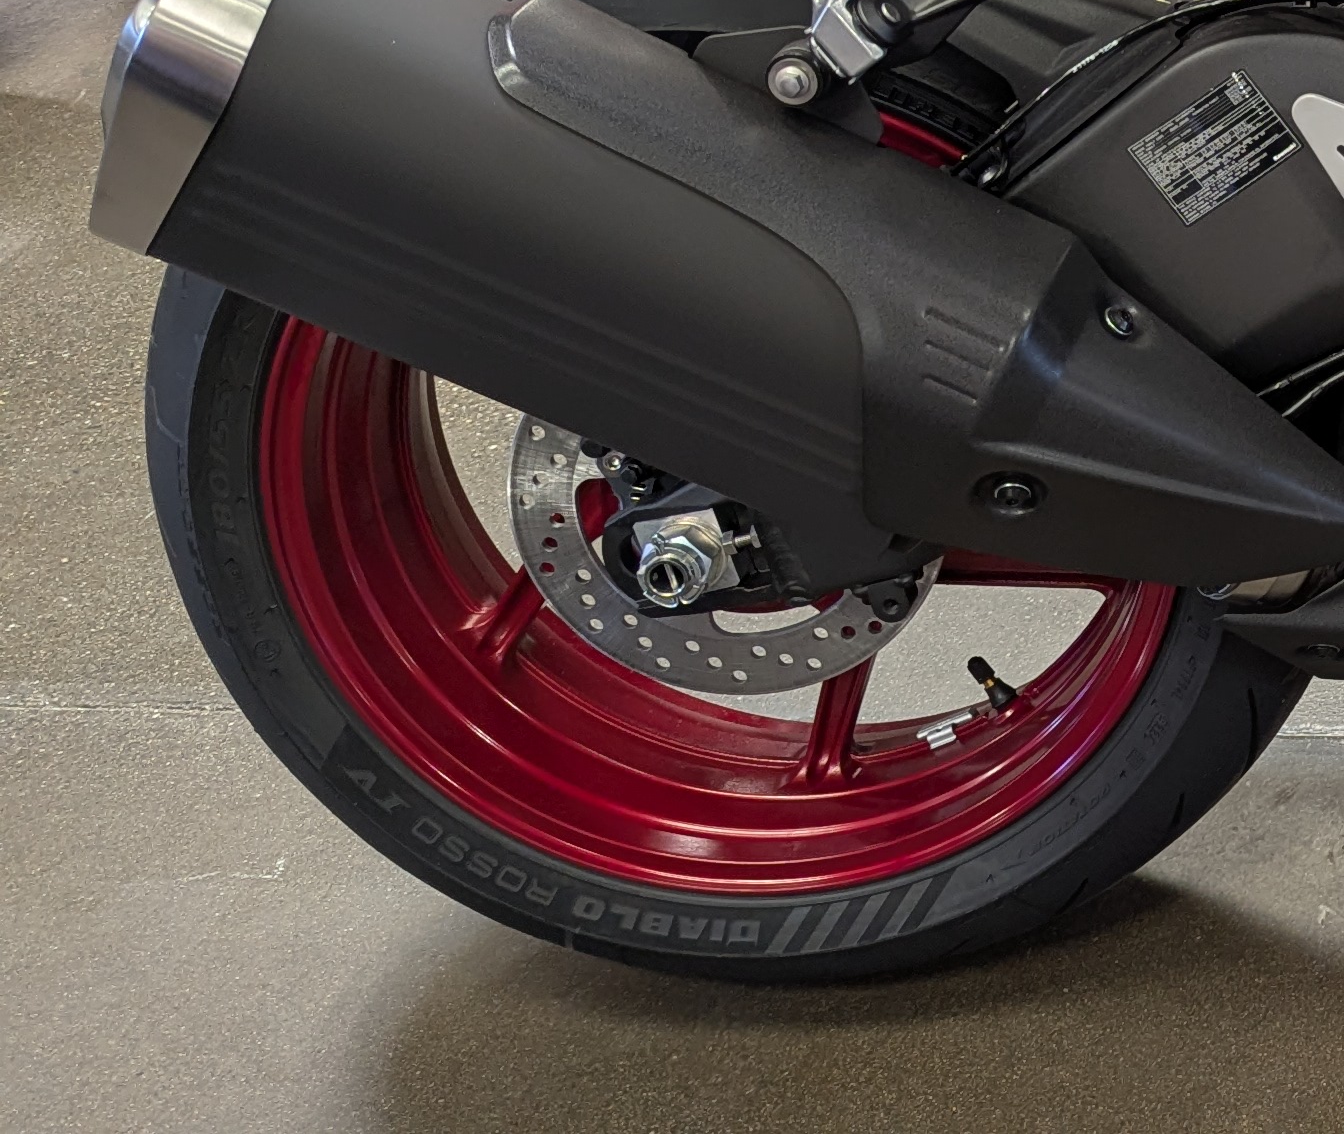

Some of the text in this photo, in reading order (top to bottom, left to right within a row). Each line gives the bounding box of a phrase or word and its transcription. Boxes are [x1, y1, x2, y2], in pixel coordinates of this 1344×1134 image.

[342, 766, 761, 946] DIABLO ROSSO IV
